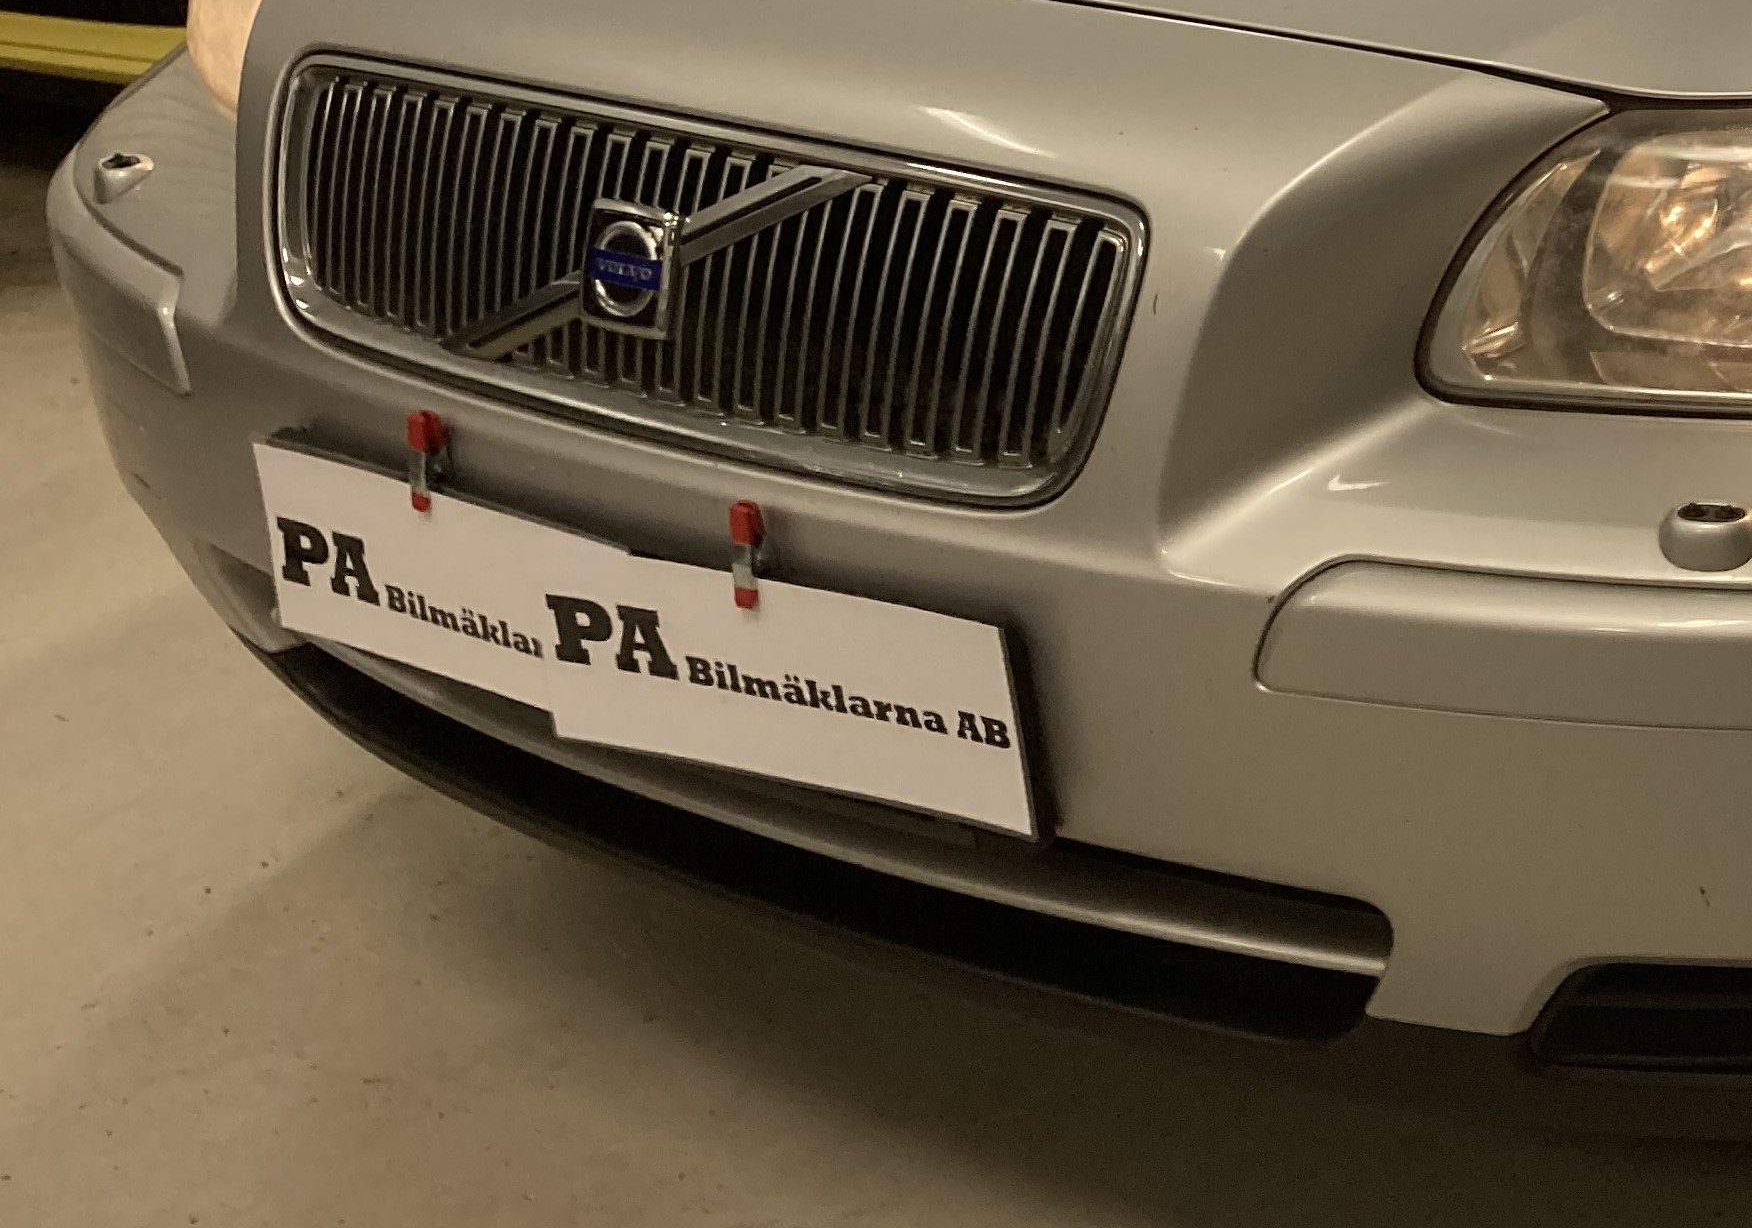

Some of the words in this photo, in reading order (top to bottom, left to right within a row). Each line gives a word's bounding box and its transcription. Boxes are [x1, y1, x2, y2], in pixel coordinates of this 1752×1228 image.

[276, 516, 381, 606] PA
[546, 593, 680, 680] PA
[686, 655, 948, 735] Bilmäklarna
[957, 710, 1011, 749] AB
